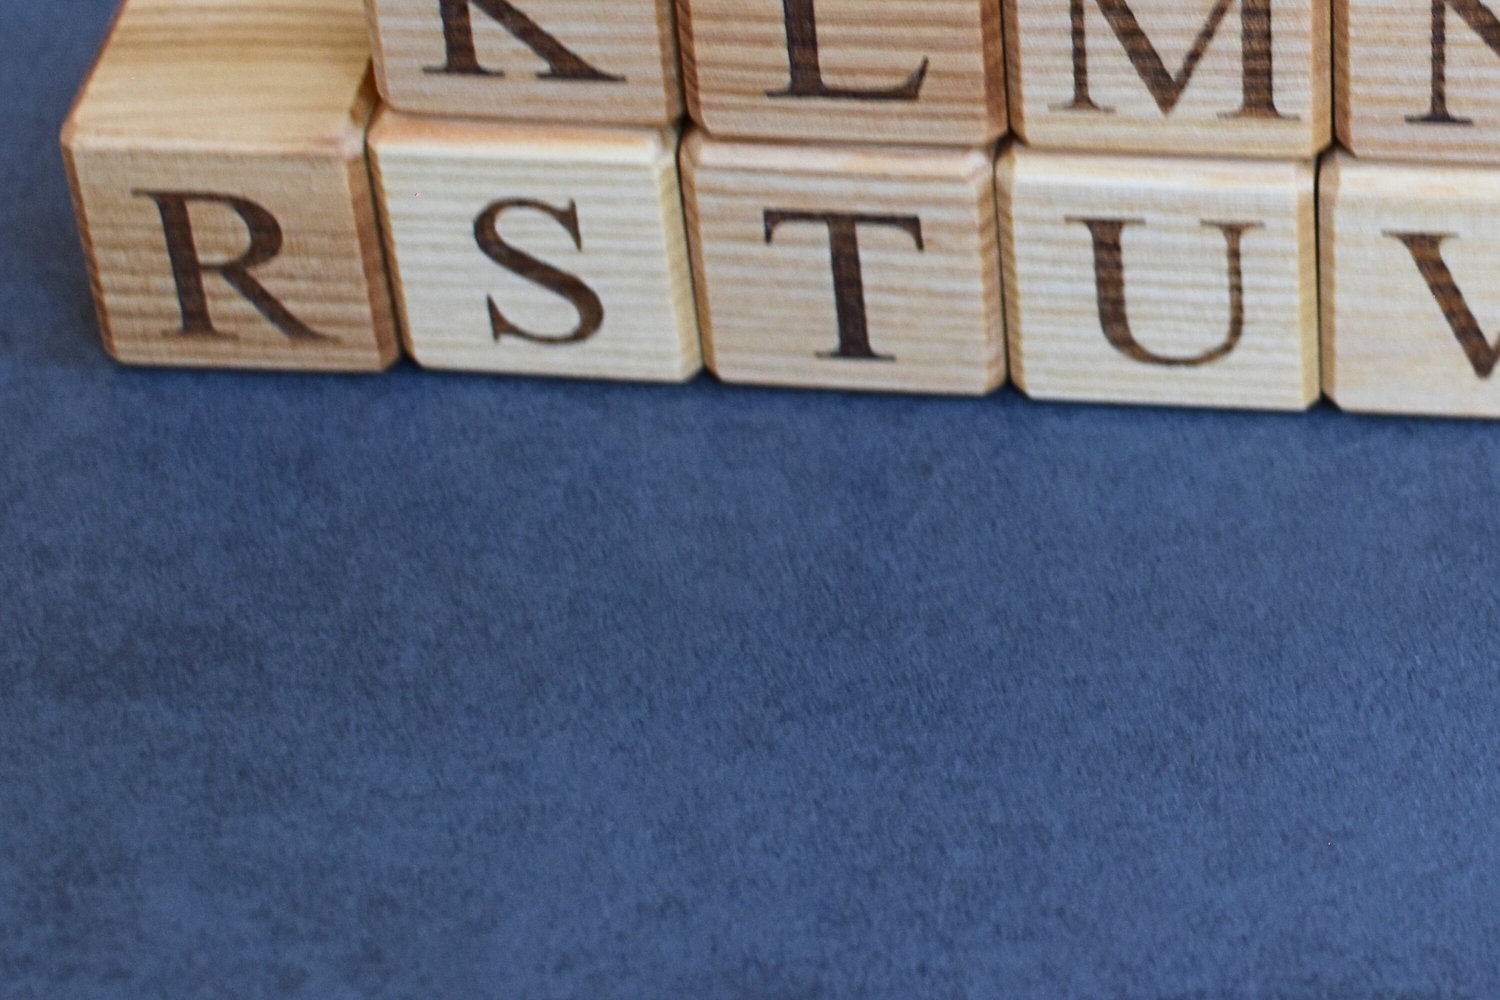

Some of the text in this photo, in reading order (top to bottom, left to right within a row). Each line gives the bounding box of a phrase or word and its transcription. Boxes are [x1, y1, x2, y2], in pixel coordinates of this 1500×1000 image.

[133, 190, 336, 346] R
[473, 198, 604, 346] S
[763, 208, 924, 361] T
[1066, 217, 1265, 367] U
